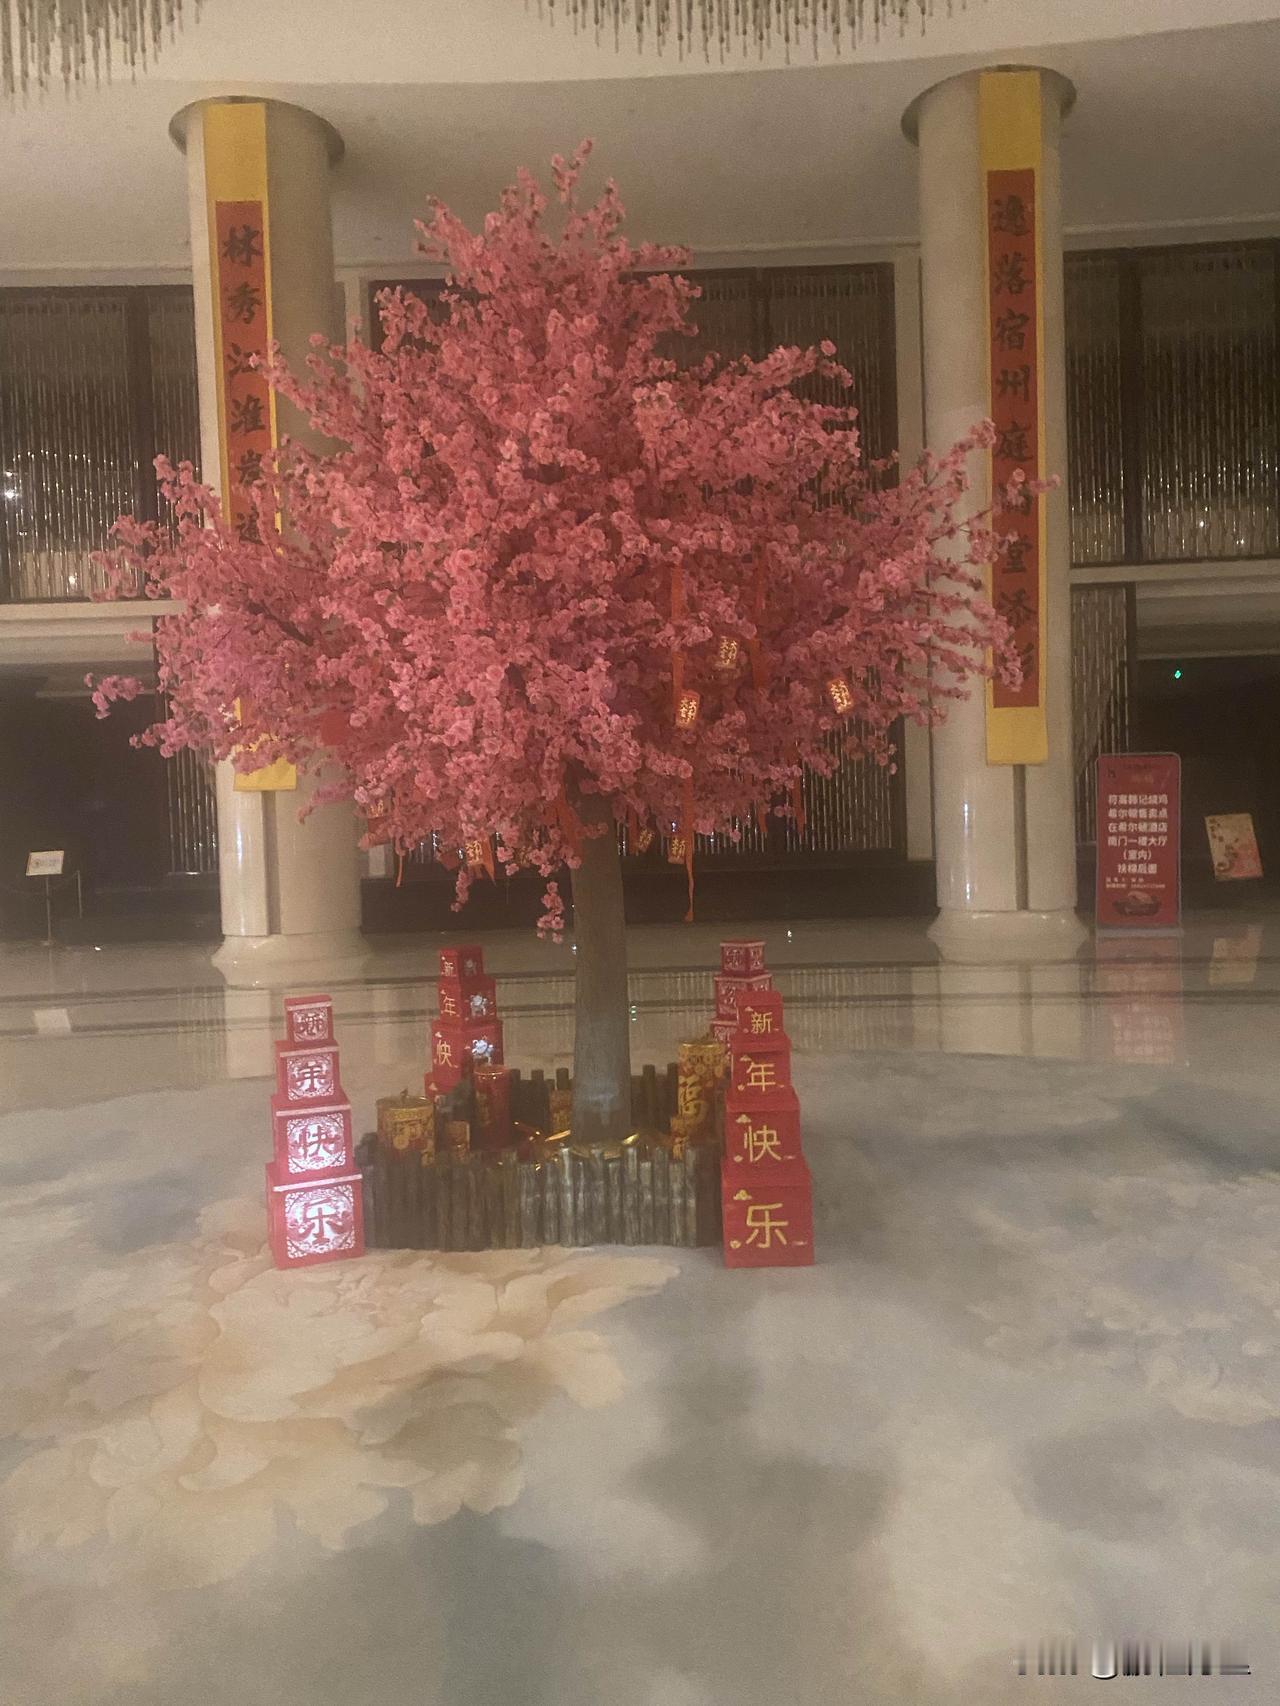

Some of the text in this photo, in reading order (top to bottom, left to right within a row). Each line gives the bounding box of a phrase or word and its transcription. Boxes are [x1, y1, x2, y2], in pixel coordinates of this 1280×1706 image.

[1107, 821, 1168, 833] 在希尔顿酒店
[1107, 835, 1168, 848] 南门一楼大厅
